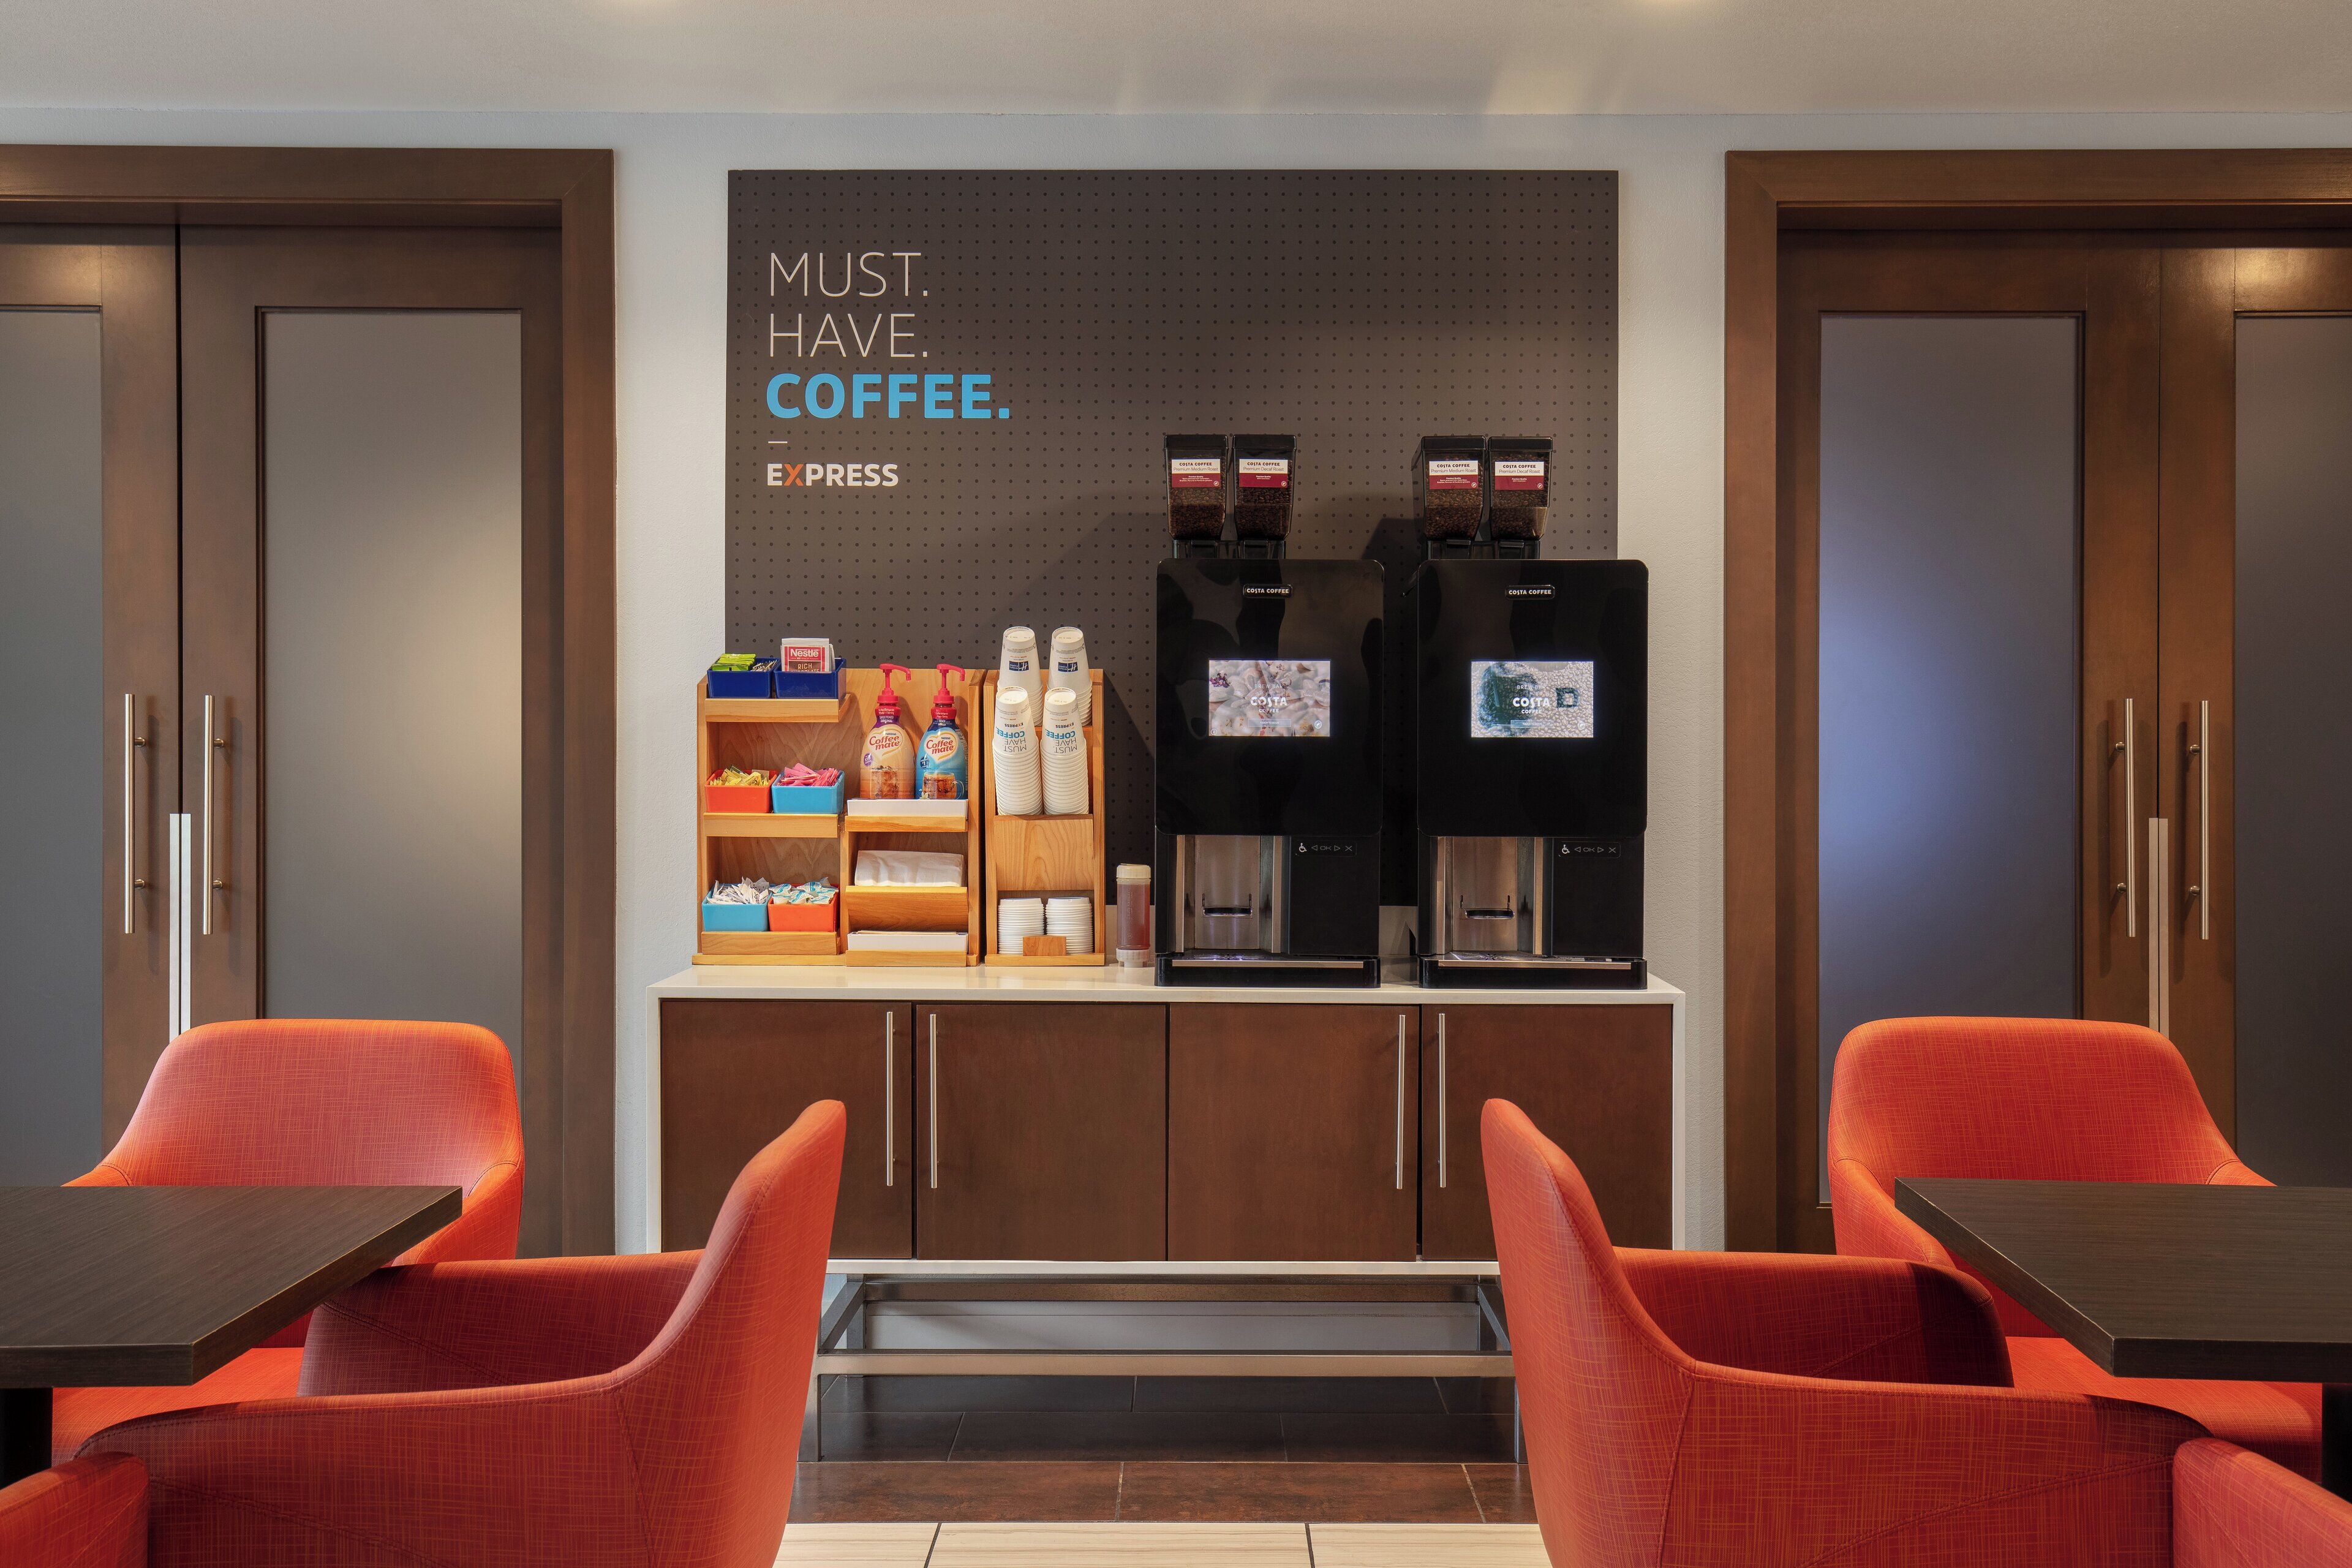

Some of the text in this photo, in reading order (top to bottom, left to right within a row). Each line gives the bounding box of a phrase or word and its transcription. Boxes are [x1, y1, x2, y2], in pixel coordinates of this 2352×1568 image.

[771, 252, 928, 297] MUST.
[770, 313, 927, 358] HAVE.
[766, 373, 1009, 418] COFFEE.
[767, 463, 899, 486] EXPRESS
[1250, 697, 1287, 707] COSTA
[1513, 697, 1550, 708] COSTA
[996, 727, 1025, 738] COFFEE.
[1045, 729, 1076, 739] COFFEE.
[869, 736, 899, 746] Coffee
[875, 741, 900, 750] mate
[926, 740, 953, 749] Coffee
[1054, 737, 1077, 746] HAVE.
[932, 745, 954, 754] mate
[1003, 744, 1027, 752] MUST.
[1053, 744, 1077, 753] MUST.
